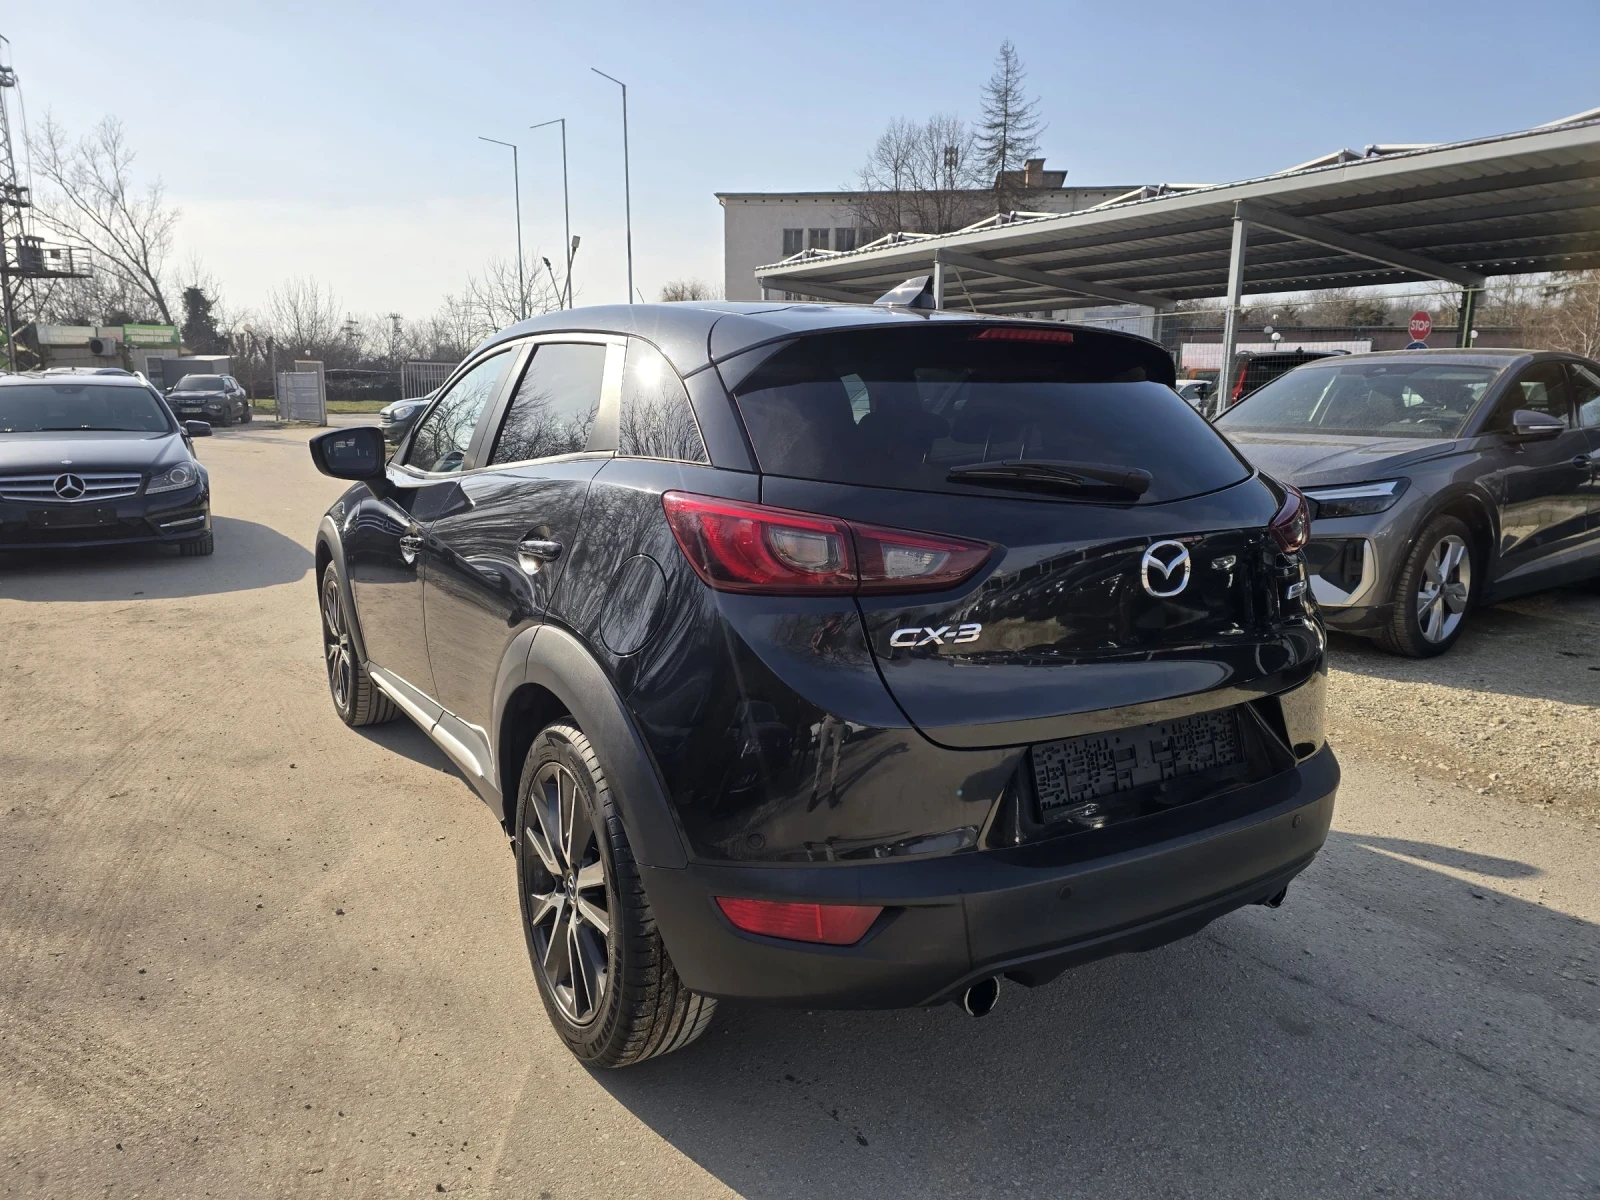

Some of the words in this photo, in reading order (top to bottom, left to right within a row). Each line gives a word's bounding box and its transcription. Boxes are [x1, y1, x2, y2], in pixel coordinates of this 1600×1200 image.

[1410, 320, 1430, 332] STOP
[889, 623, 982, 647] CX-3
[590, 947, 622, 1053] IMPERIAL
